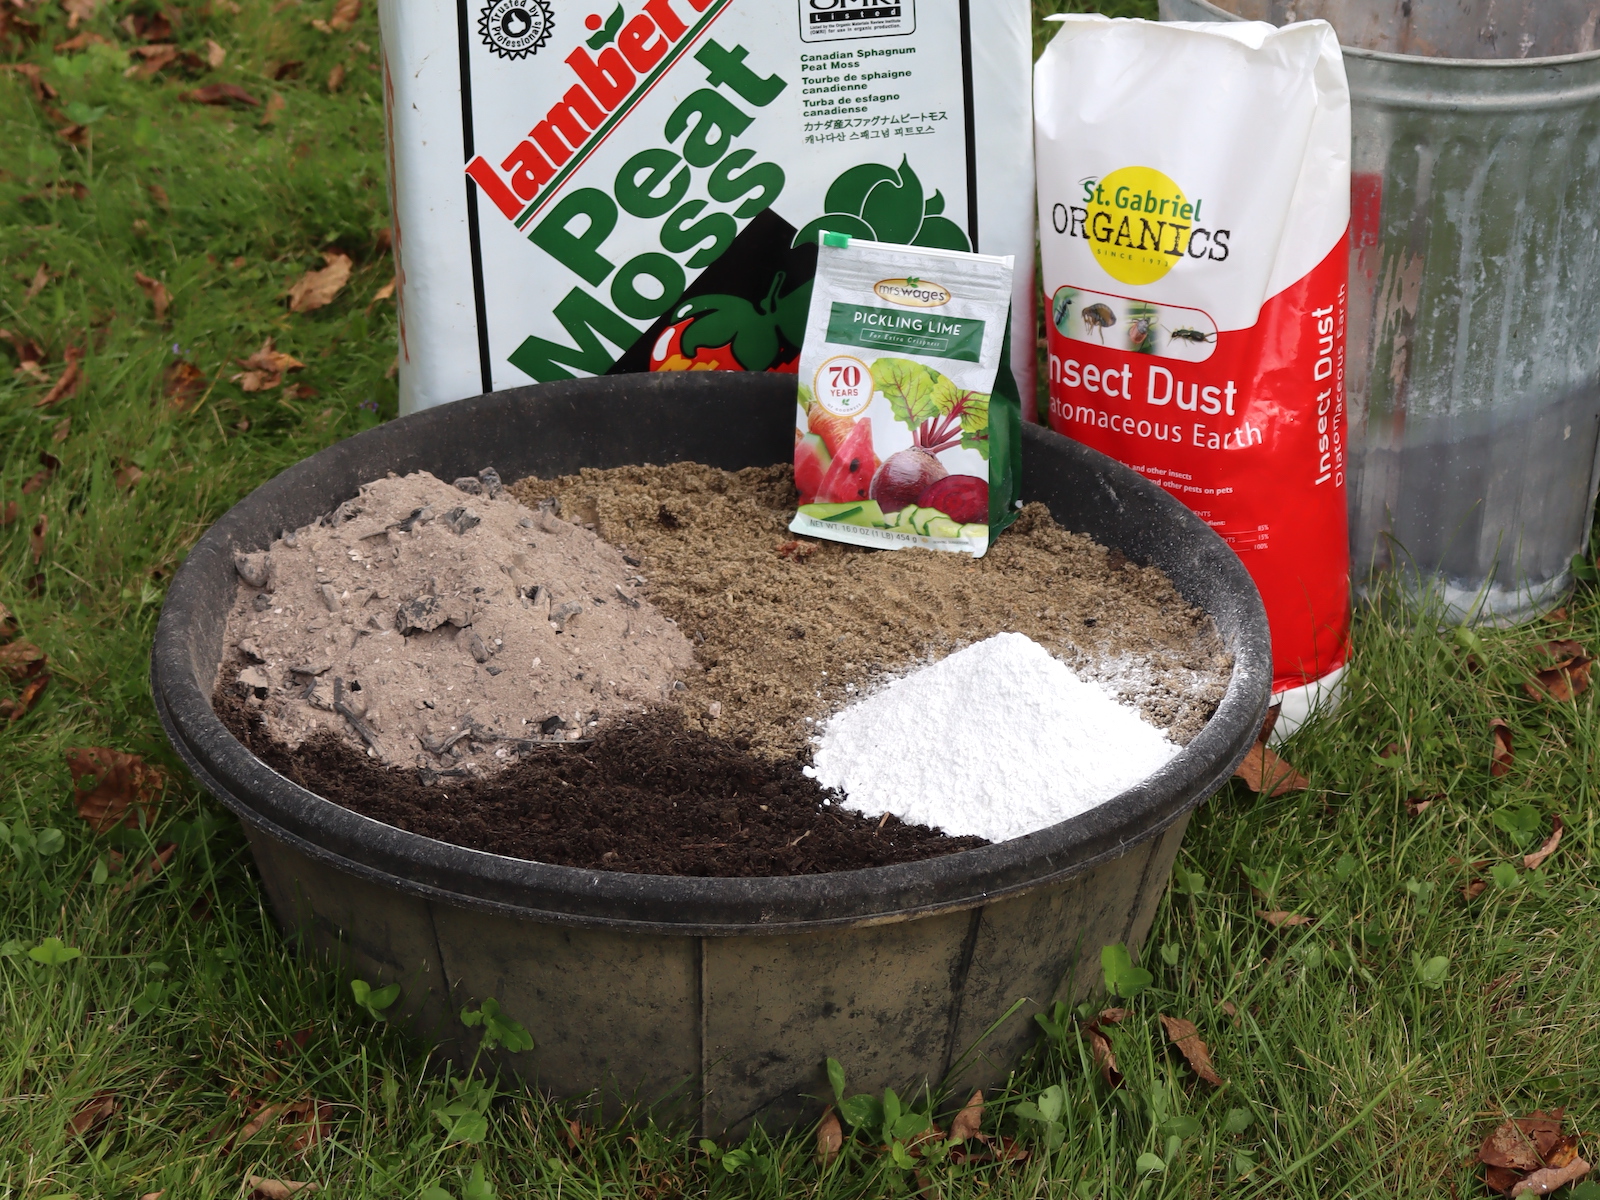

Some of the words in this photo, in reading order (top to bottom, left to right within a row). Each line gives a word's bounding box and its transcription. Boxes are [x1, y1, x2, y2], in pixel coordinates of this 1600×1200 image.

[491, 0, 527, 23] Trusted
[528, 5, 540, 18] by
[815, 8, 896, 21] Listed
[491, 21, 542, 47] Professionals
[800, 51, 853, 62] Canadian
[857, 46, 916, 59] Sphagnum
[801, 62, 827, 72] Peat
[830, 61, 860, 70] Moss
[802, 73, 840, 85] Tourbe
[844, 73, 857, 82] de
[861, 69, 912, 81] sphaigne
[802, 83, 868, 95] canadienne
[803, 98, 834, 108] Turba
[838, 96, 851, 105] de
[855, 93, 900, 103] esfagno
[803, 106, 868, 117] canadiense
[527, 38, 788, 288] Peat
[1082, 180, 1110, 207] St.
[1115, 185, 1202, 222] Gabriel
[1052, 202, 1231, 262] ORGANICS
[507, 149, 786, 383] Moss
[1097, 248, 1132, 261] SINCE
[879, 284, 900, 296] mrs
[901, 287, 945, 302] wages
[1336, 283, 1346, 339] Earth
[854, 311, 923, 331] PICKLING
[928, 321, 962, 336] LIME
[869, 331, 882, 339] For
[884, 333, 904, 342] Extra
[907, 336, 941, 347] Crispness
[1312, 304, 1334, 381] Dust
[829, 365, 861, 388] 70
[1050, 353, 1133, 401] nsect
[1147, 364, 1237, 416] Dust
[830, 388, 859, 397] YEARS
[1050, 396, 1183, 443] atomaceous
[1193, 421, 1263, 450] Earth
[1333, 345, 1345, 488] Diatomaceous
[1315, 387, 1332, 486] Insect
[1132, 464, 1145, 472] and
[1146, 466, 1167, 476] other
[1168, 468, 1193, 481] insects
[1163, 480, 1182, 490] other
[1183, 484, 1202, 494] pests
[1204, 487, 1214, 495] on
[1216, 486, 1234, 496] pets
[809, 518, 823, 528] NET
[825, 522, 840, 530] WT.
[842, 525, 858, 534] 16.0
[860, 527, 870, 536] OZ
[871, 529, 879, 537] (1
[881, 531, 894, 540] LB)
[896, 533, 910, 541] 454
[1258, 533, 1270, 541] 15%
